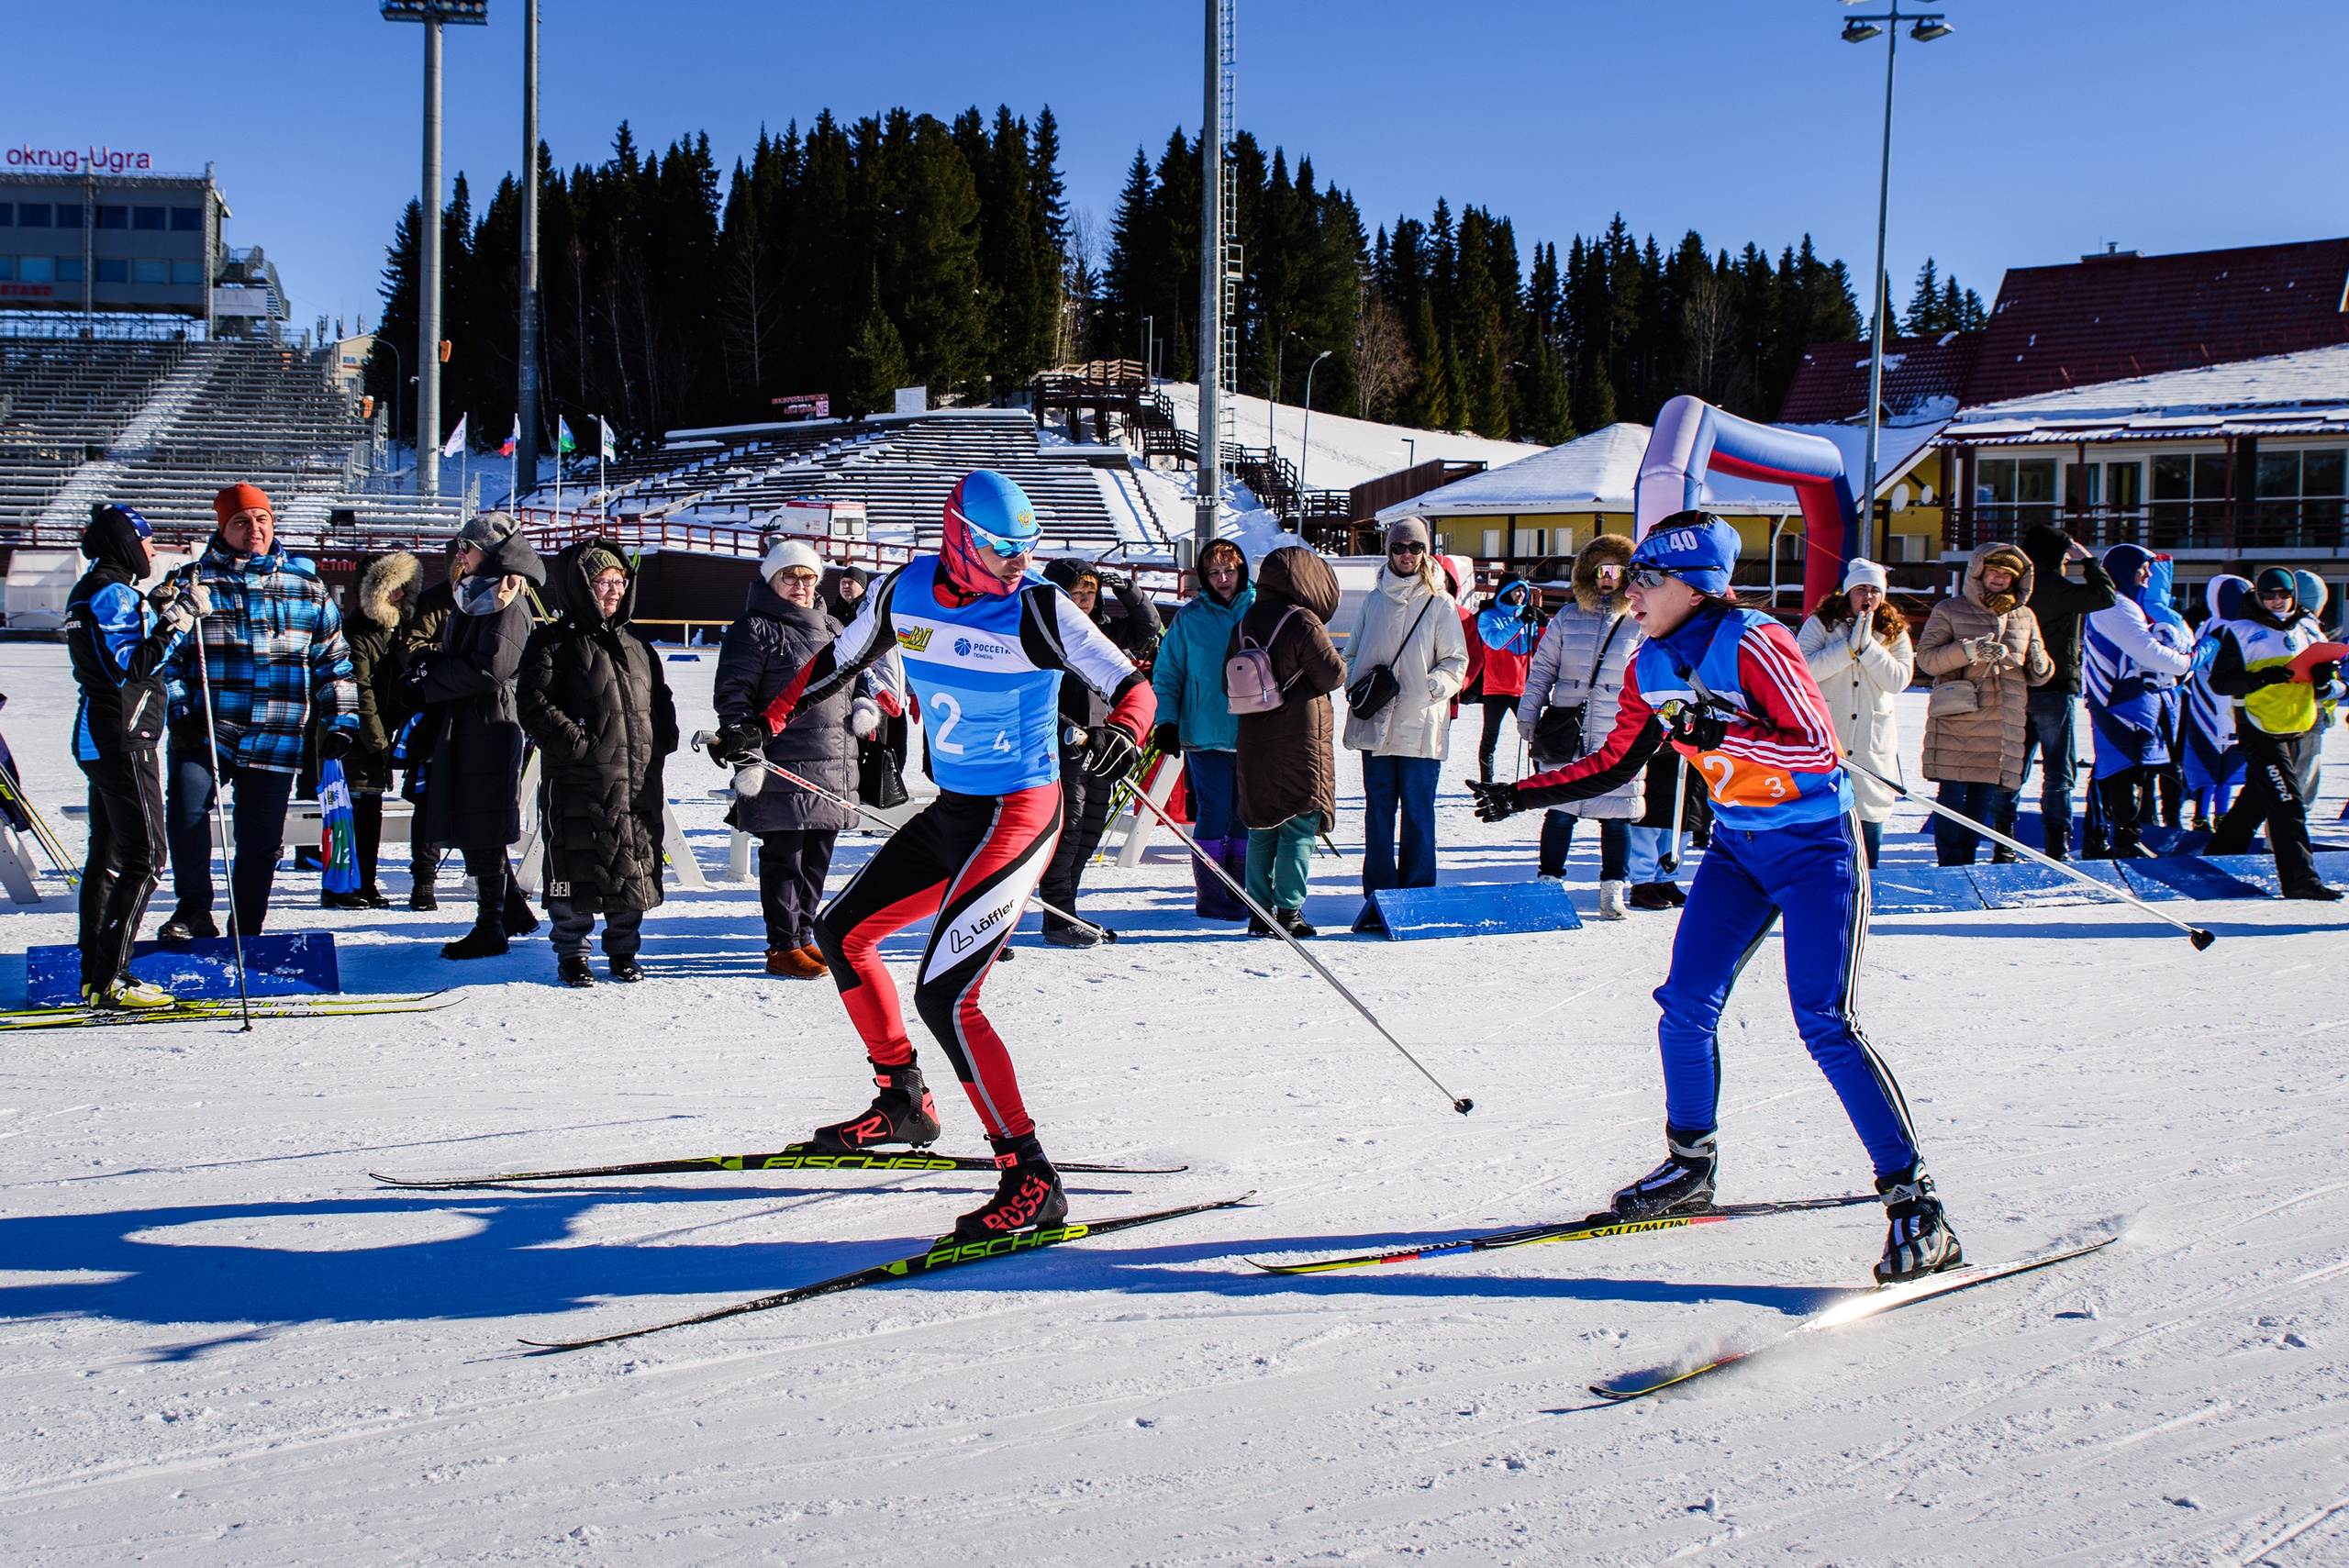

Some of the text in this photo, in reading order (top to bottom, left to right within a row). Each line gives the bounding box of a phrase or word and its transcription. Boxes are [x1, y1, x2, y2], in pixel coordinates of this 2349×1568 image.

[6, 143, 152, 173] okrug-Ugra
[817, 403, 828, 415] NE
[964, 538, 982, 565] CRAFT
[1642, 530, 1698, 557] VR40
[974, 652, 994, 661] ТЮМЕНЬ
[930, 692, 963, 754] 2
[993, 730, 1011, 754] 4
[1702, 755, 1742, 807] 2
[1765, 777, 1786, 798] 3
[970, 898, 1015, 935] Löffler
[82, 1014, 148, 1026] FISCHER
[763, 1155, 957, 1171] FISCHER
[1892, 1192, 1912, 1202] adidas
[1589, 1218, 1688, 1238] SALOMON
[926, 1224, 1089, 1269] FISCHER
